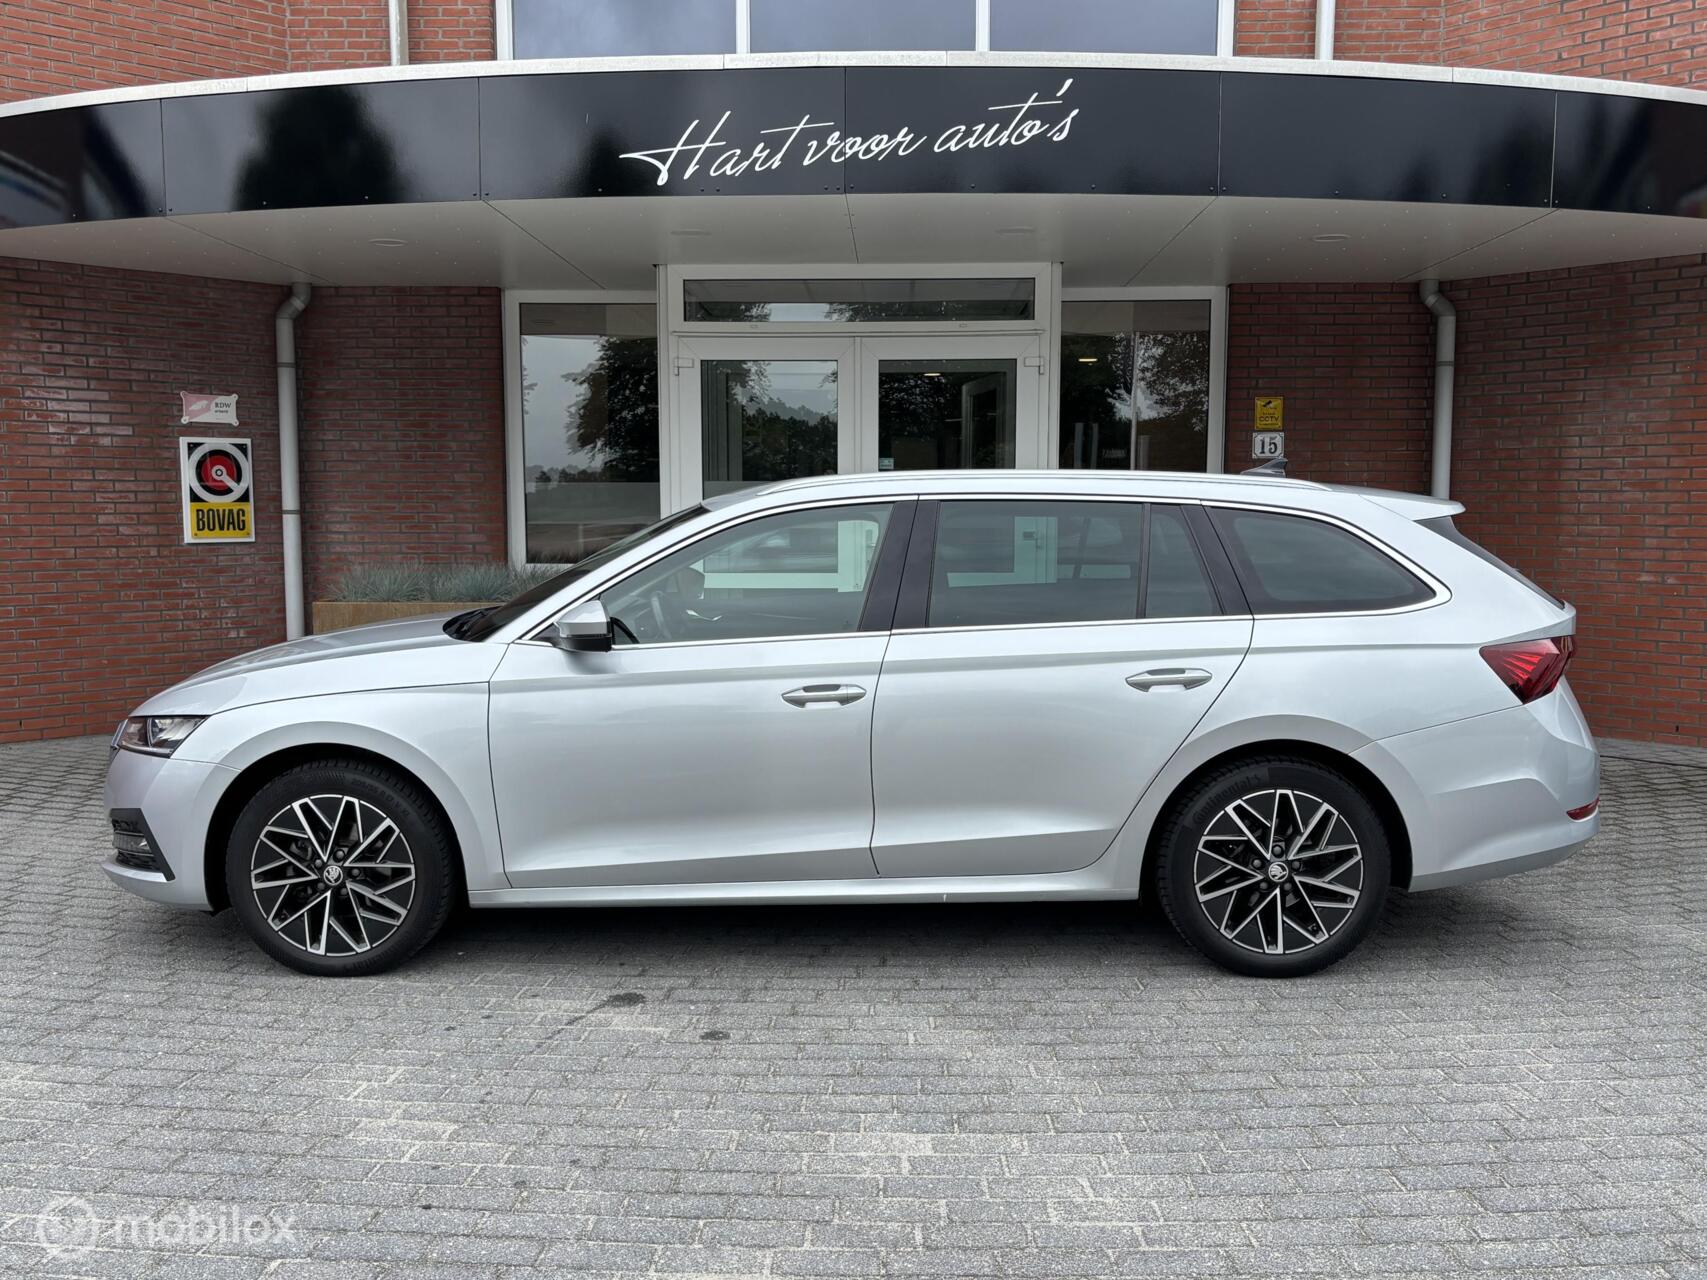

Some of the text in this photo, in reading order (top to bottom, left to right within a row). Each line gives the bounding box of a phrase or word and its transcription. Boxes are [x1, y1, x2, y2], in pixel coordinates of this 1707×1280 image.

[619, 78, 1080, 186] Hart voor auto's
[1259, 436, 1278, 454] 15
[196, 508, 246, 531] BOVAG
